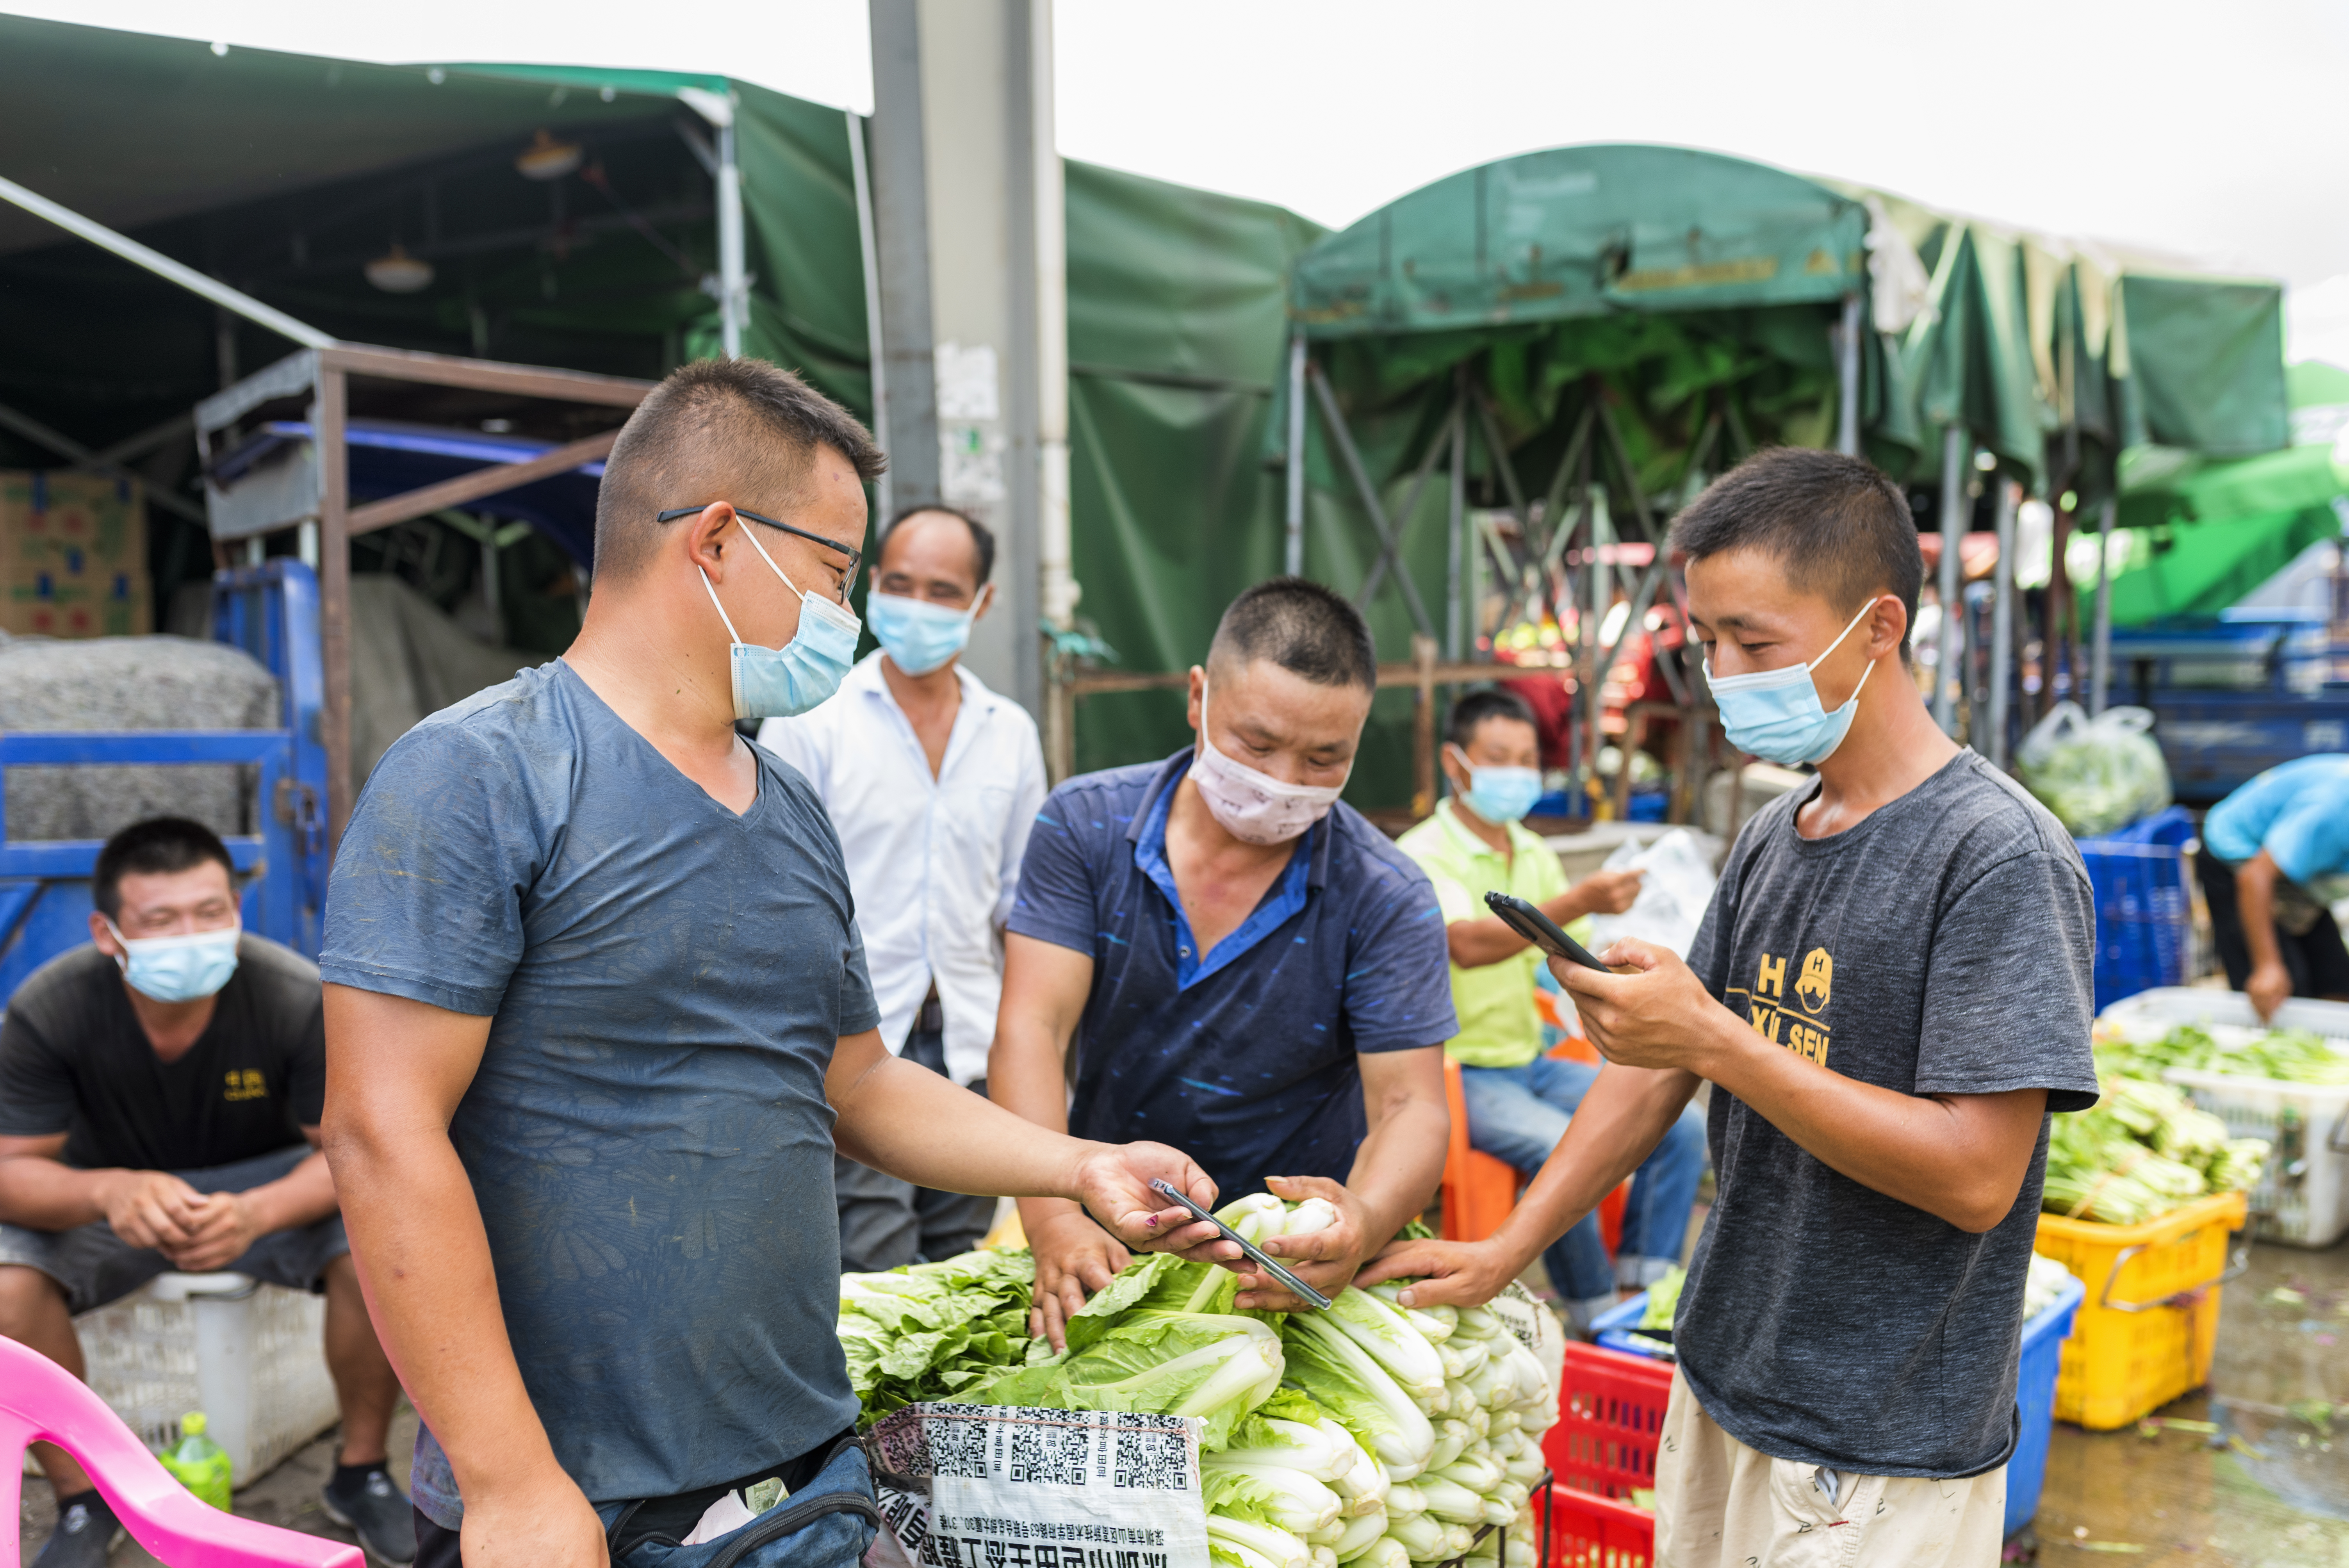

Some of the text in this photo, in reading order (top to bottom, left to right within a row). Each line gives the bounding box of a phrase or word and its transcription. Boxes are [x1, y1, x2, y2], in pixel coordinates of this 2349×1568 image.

[1757, 952, 1786, 998] H
[1813, 956, 1824, 972] H
[1787, 1023, 1830, 1067] SEN
